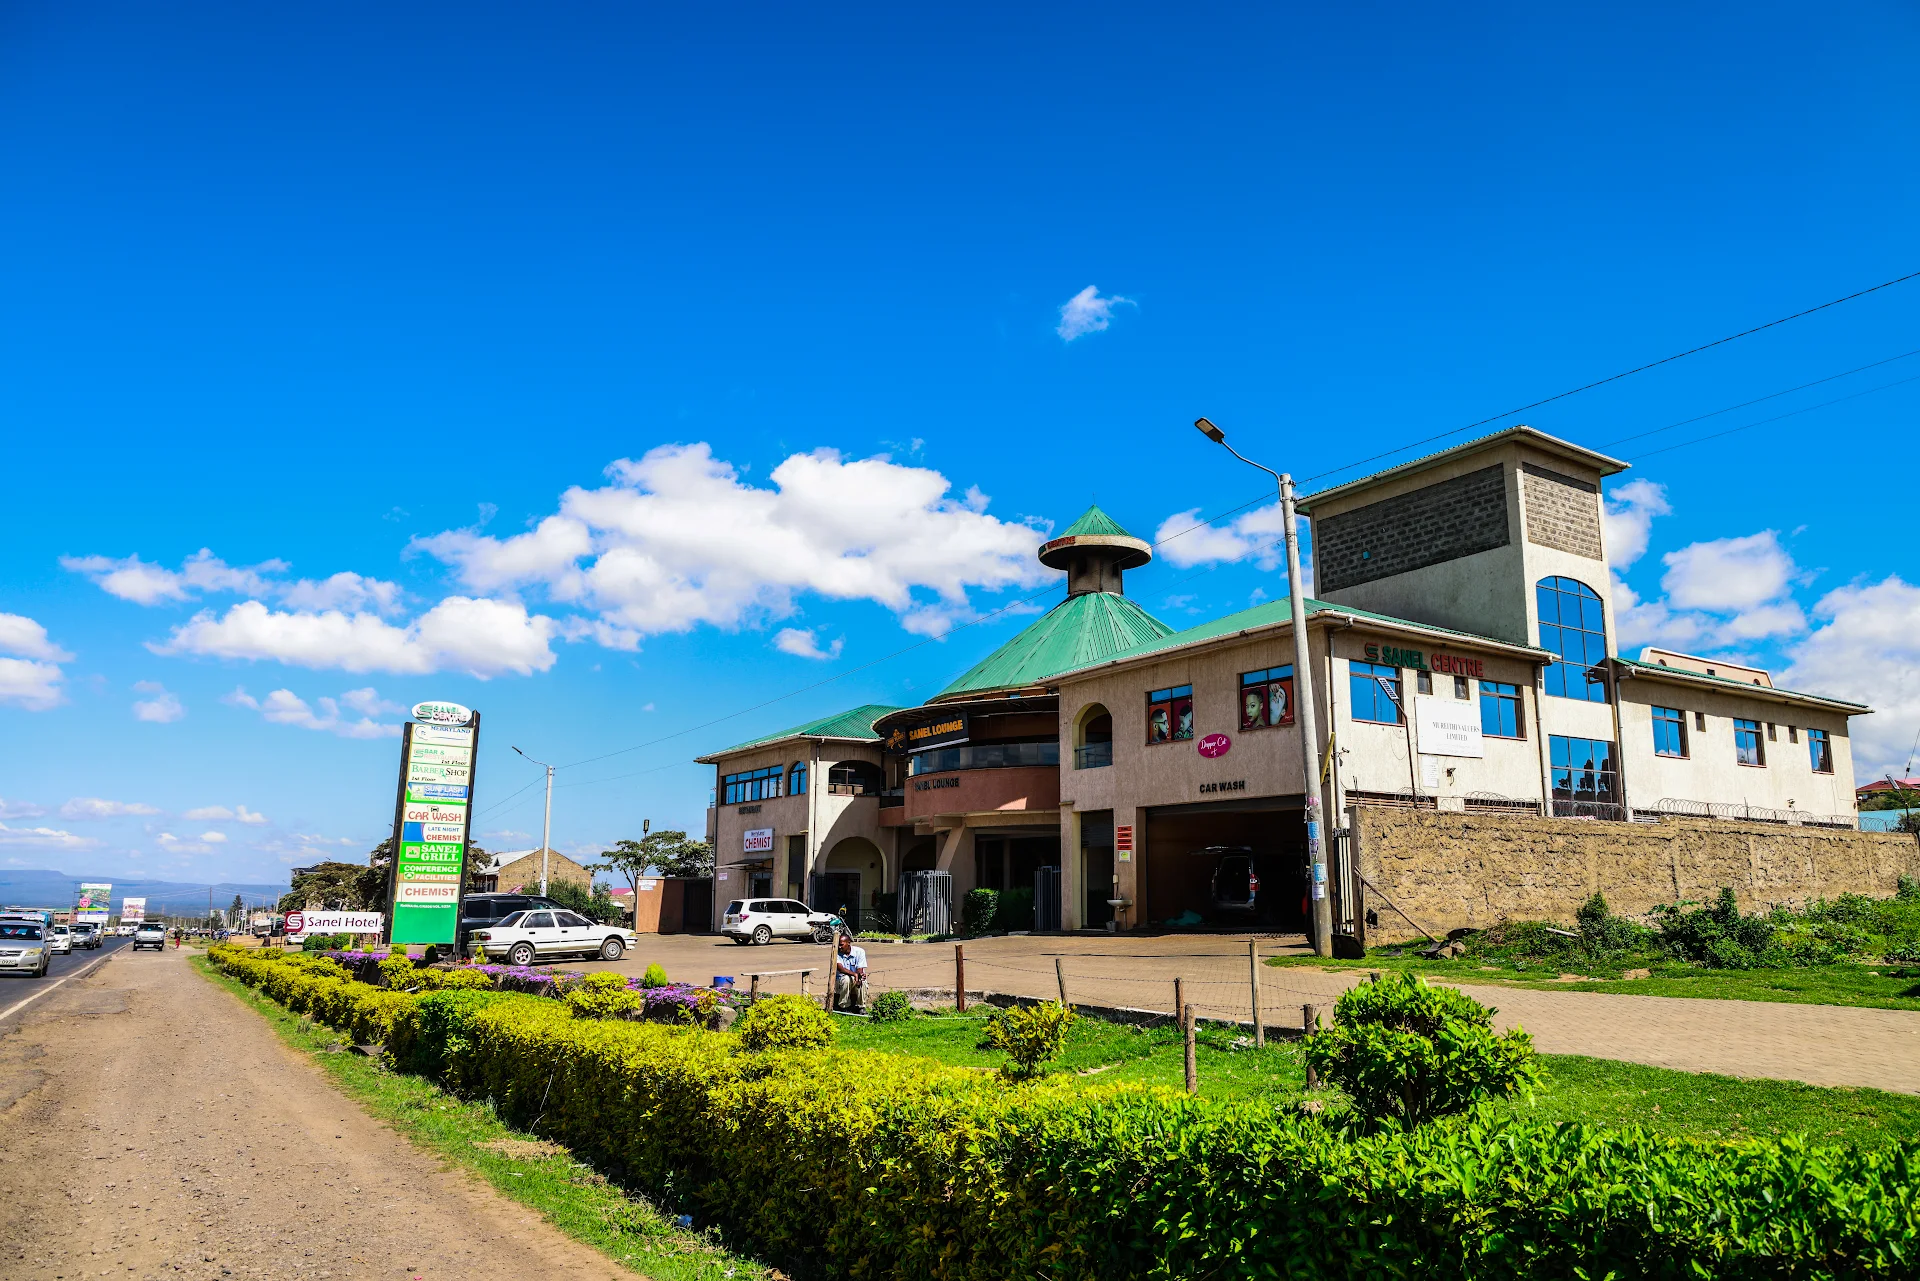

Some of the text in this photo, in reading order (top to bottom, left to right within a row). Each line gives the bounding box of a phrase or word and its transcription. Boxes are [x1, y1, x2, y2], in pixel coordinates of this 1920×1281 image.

[1382, 646, 1428, 670] SANEL
[1431, 653, 1484, 677] CENTRE
[431, 725, 470, 733] MERRYLAND
[909, 727, 932, 740] SANEL
[932, 720, 963, 735] LOUNGE
[1199, 780, 1245, 793] CAR WASH
[408, 811, 462, 822] CAR WASH
[745, 837, 771, 849] CHEMIST
[421, 844, 459, 854] SANEL
[421, 853, 459, 862] GRILL
[404, 865, 458, 873] CONFERENCE
[405, 888, 456, 897] CHEMIST
[308, 917, 341, 927] Sanel
[345, 917, 379, 928] Hotel
